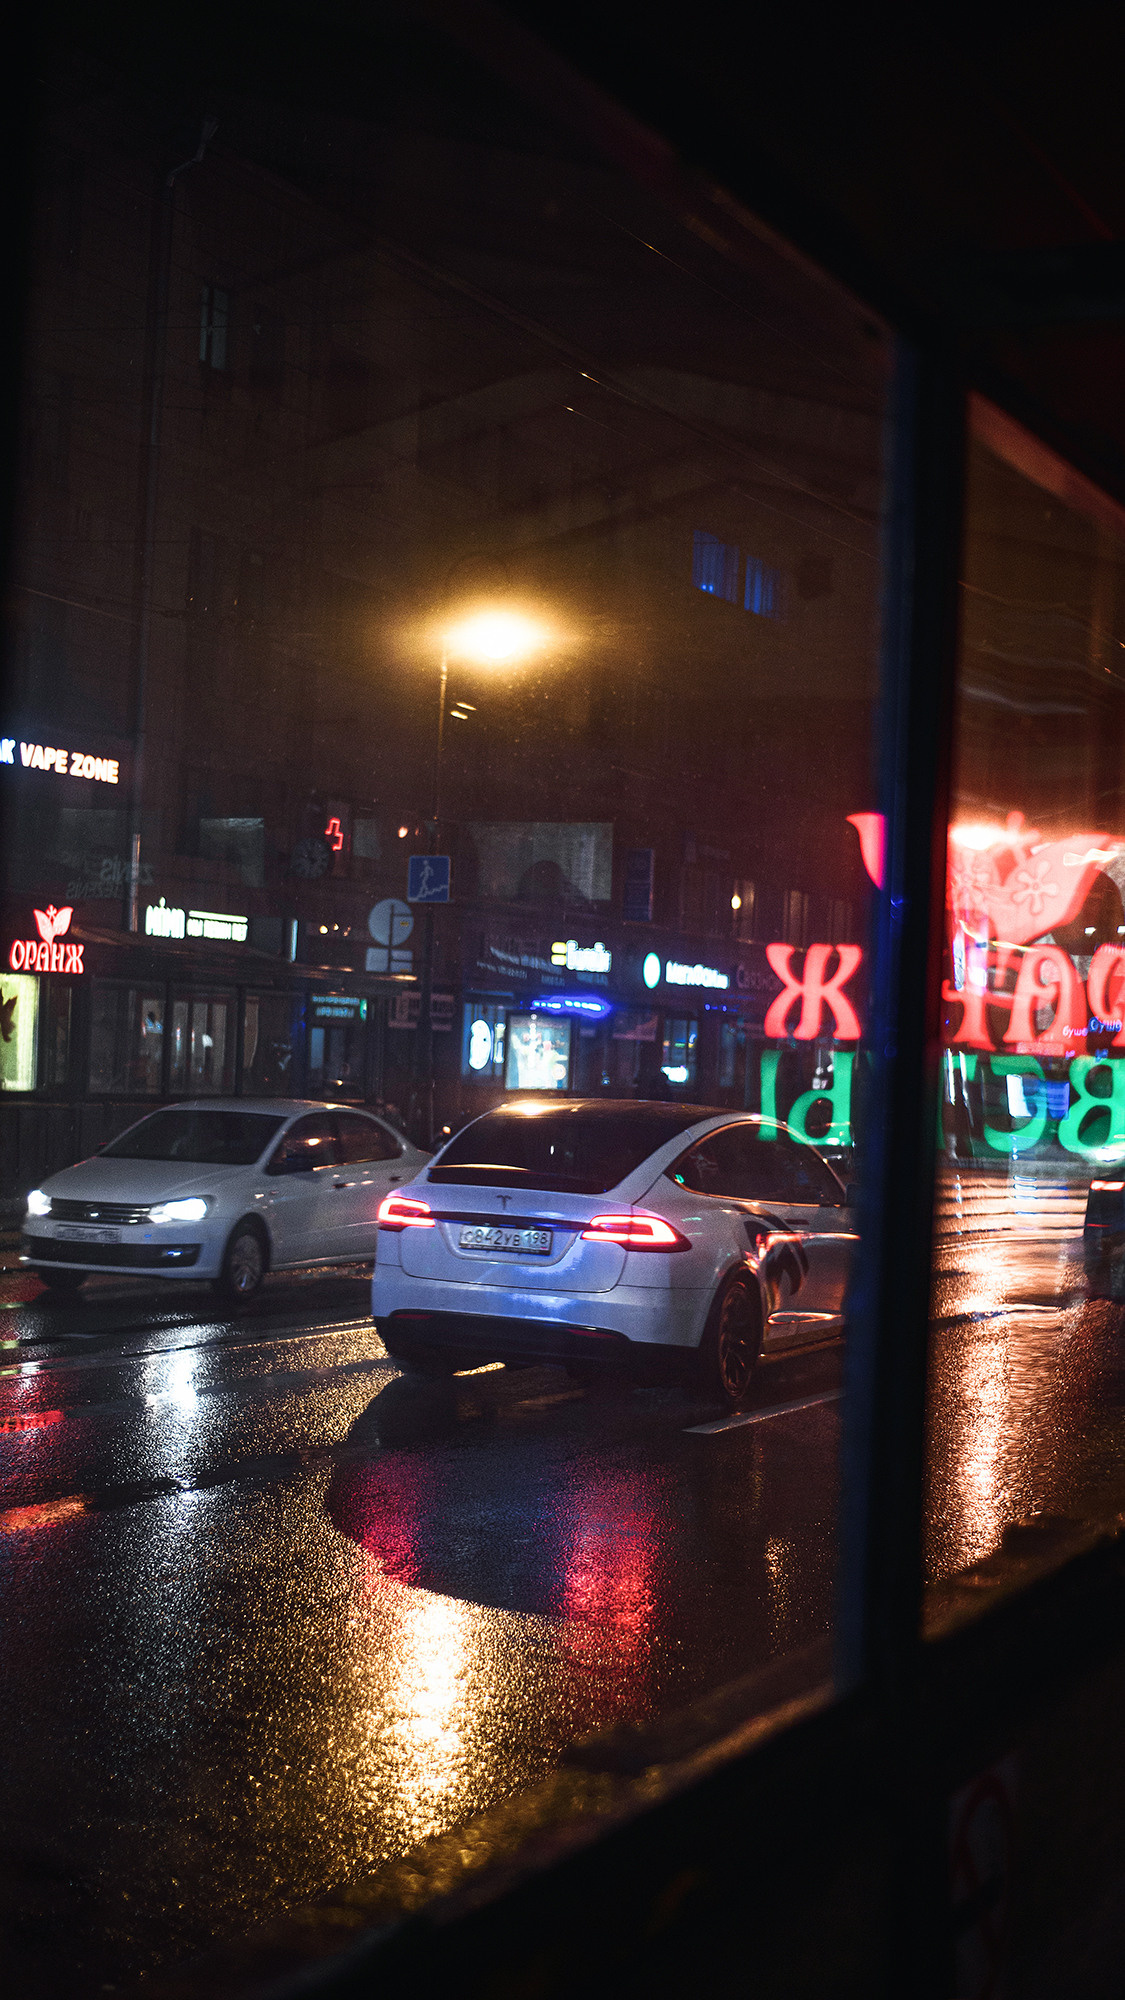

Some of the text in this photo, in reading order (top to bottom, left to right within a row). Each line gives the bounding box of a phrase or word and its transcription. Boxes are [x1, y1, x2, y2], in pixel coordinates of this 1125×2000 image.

[20, 741, 68, 774] VAPE
[70, 752, 119, 784] ZONE
[9, 939, 85, 975] ОРАНЖ
[525, 1231, 548, 1245] 198
